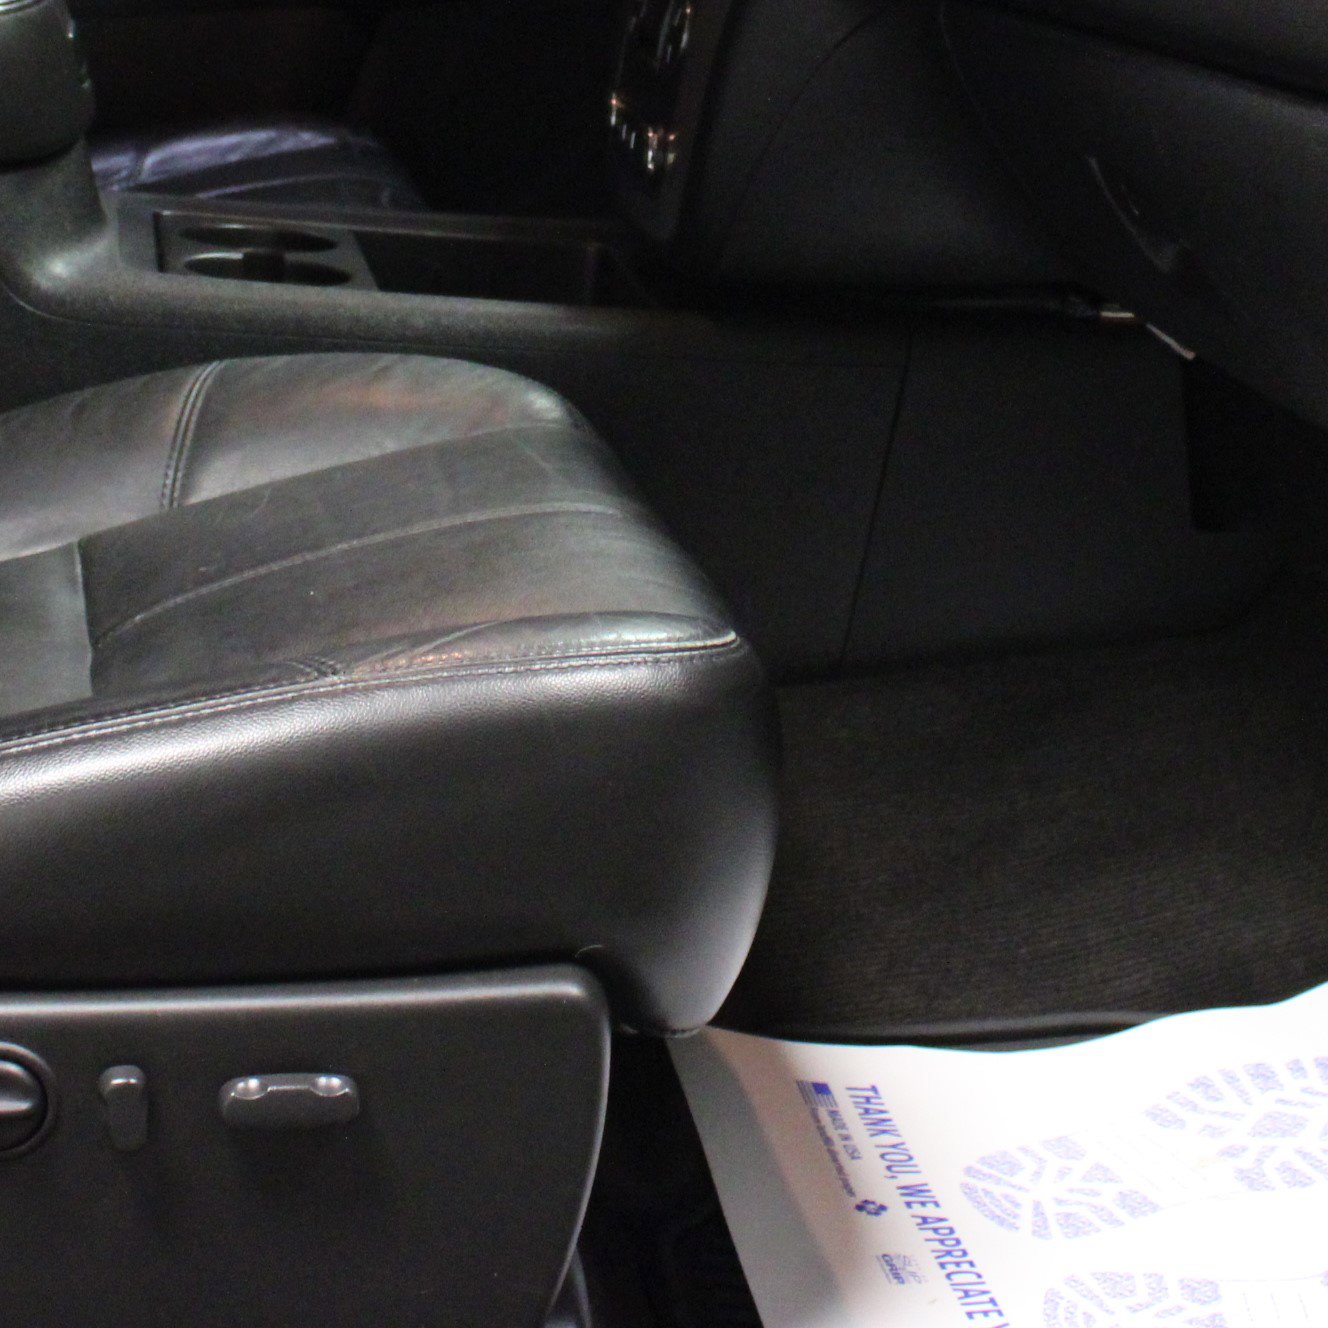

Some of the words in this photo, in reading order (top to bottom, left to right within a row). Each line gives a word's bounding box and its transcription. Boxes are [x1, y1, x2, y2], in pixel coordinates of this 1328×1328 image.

[845, 1085, 902, 1137] THANK
[874, 1142, 921, 1179] YOU,
[896, 1183, 942, 1209] WE
[911, 1214, 1005, 1320] APPRECIATE
